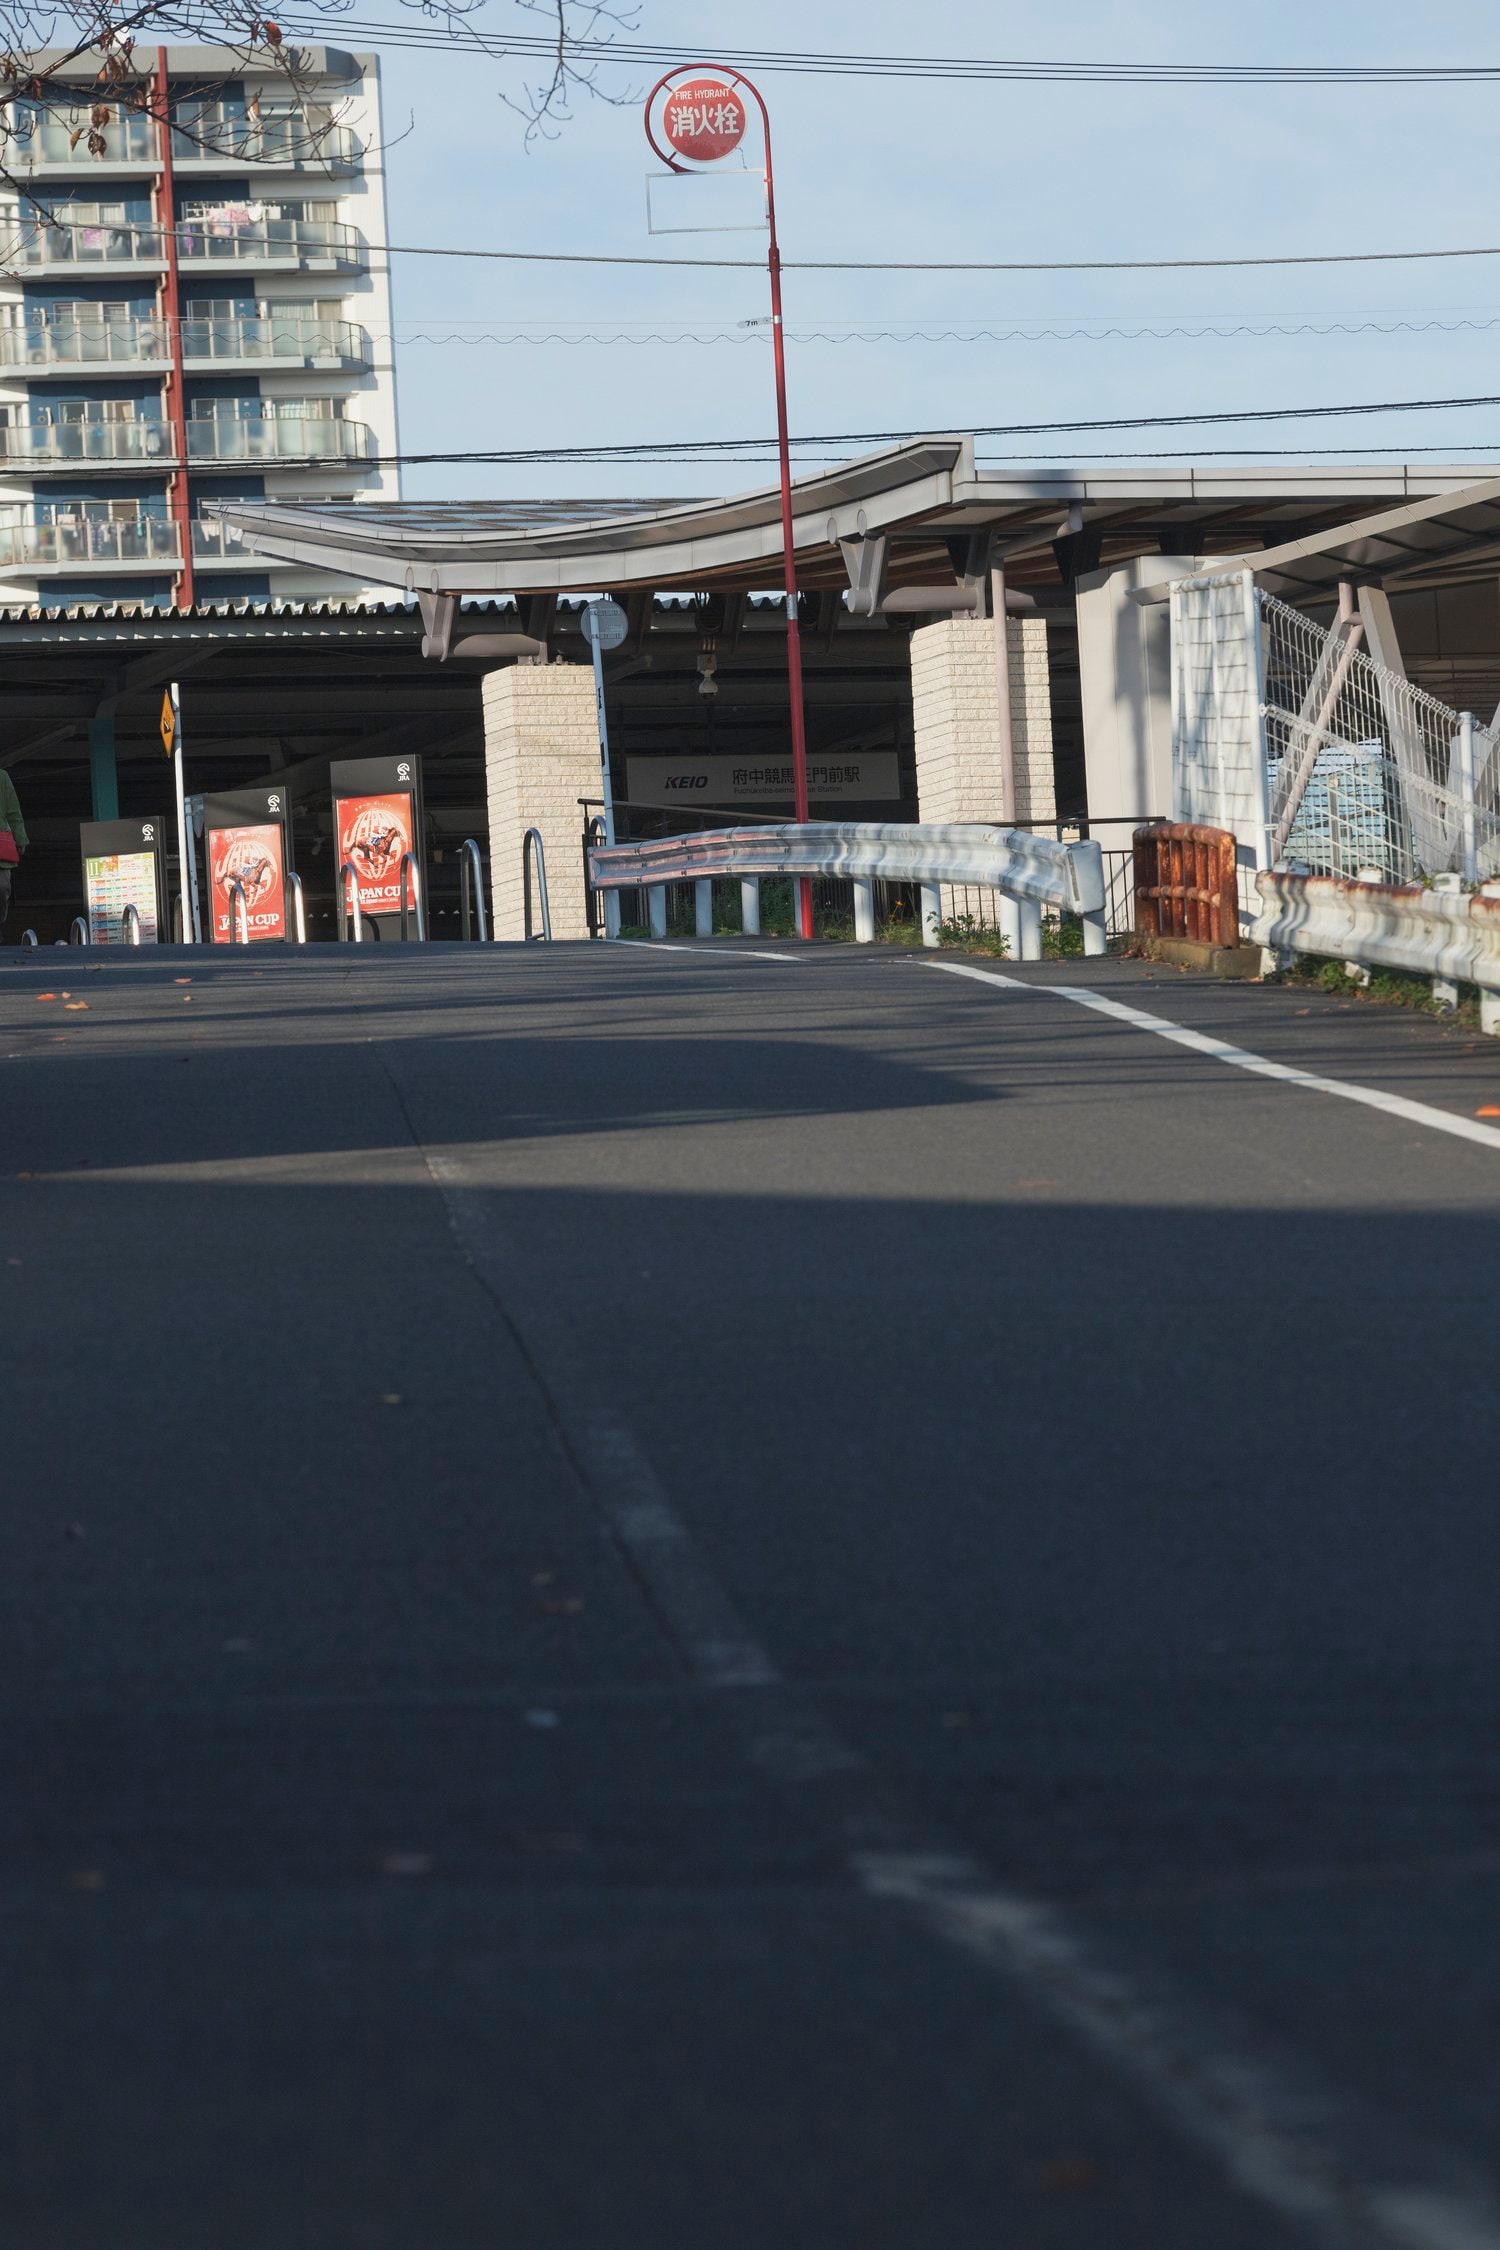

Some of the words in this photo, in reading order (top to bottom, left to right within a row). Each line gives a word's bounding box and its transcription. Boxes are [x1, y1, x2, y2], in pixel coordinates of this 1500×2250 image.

[675, 90, 692, 100] FIRE
[695, 88, 730, 99] HYDRANT
[670, 102, 740, 138] 消火栓
[664, 775, 708, 789] KEIO
[817, 785, 843, 793] Station
[384, 885, 410, 897] CU
[255, 913, 280, 926] CUP
